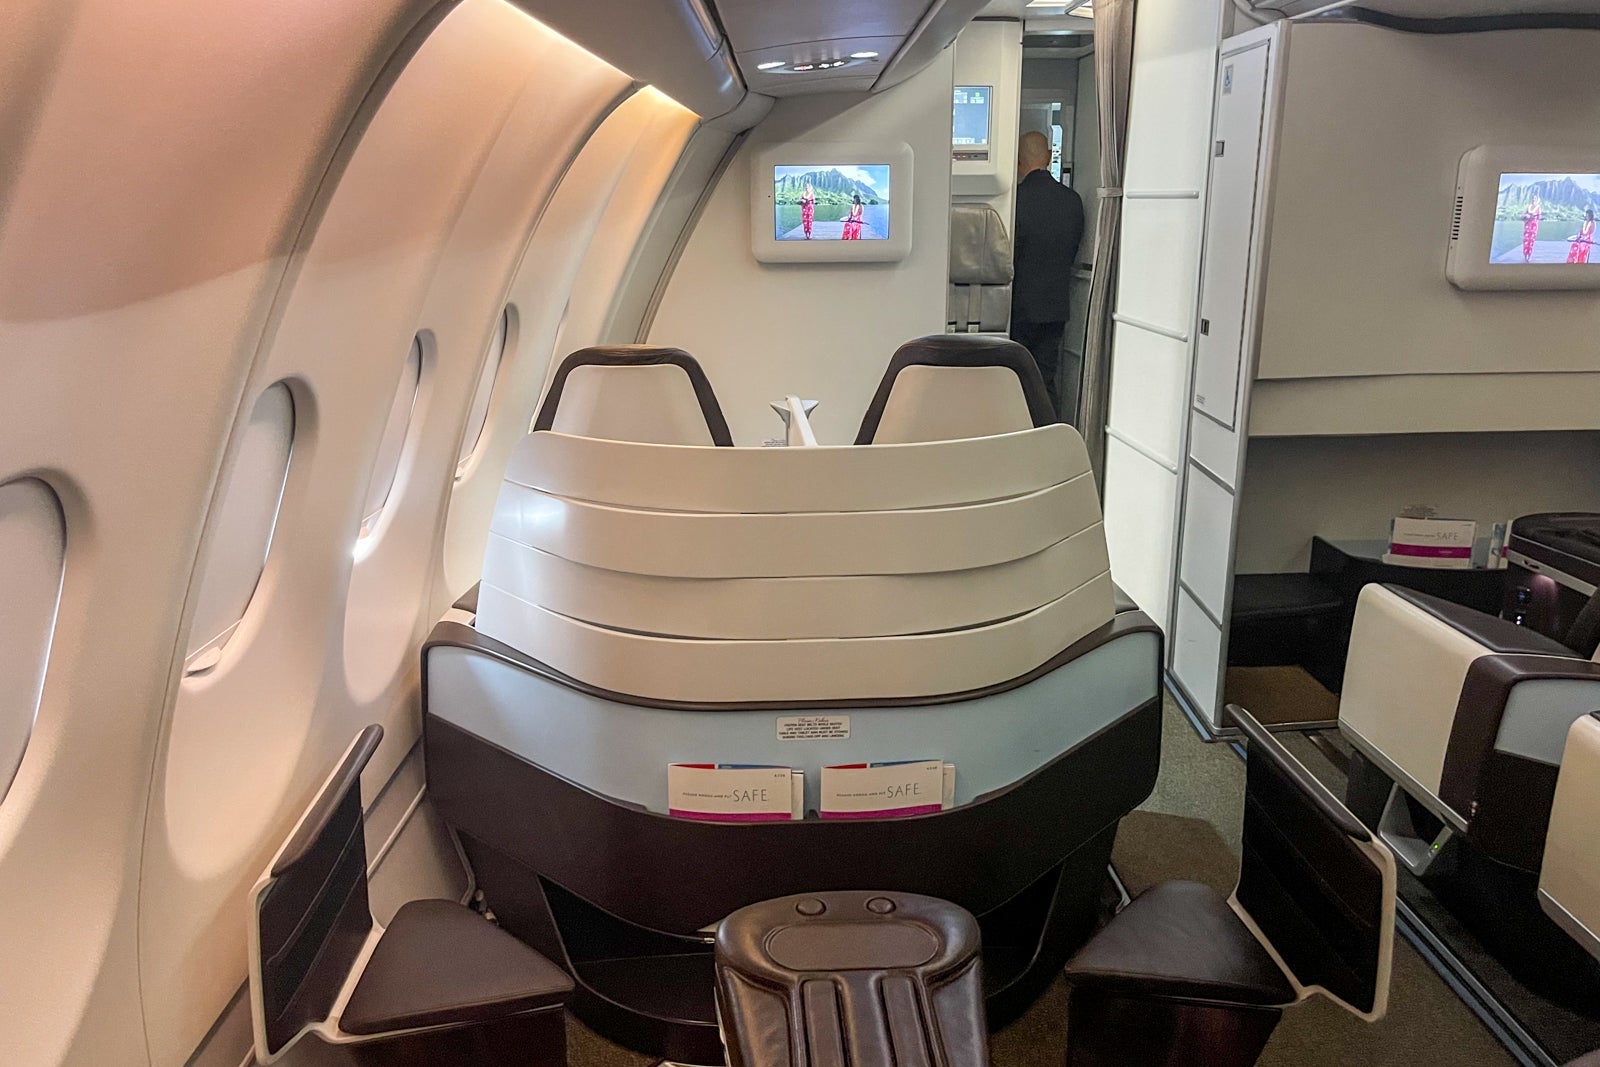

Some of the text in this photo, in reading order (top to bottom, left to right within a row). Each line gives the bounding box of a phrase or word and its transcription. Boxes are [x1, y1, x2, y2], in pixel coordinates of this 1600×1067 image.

[1436, 531, 1459, 541] SAFE
[733, 789, 768, 802] SAFE
[887, 783, 921, 798] SAFE
